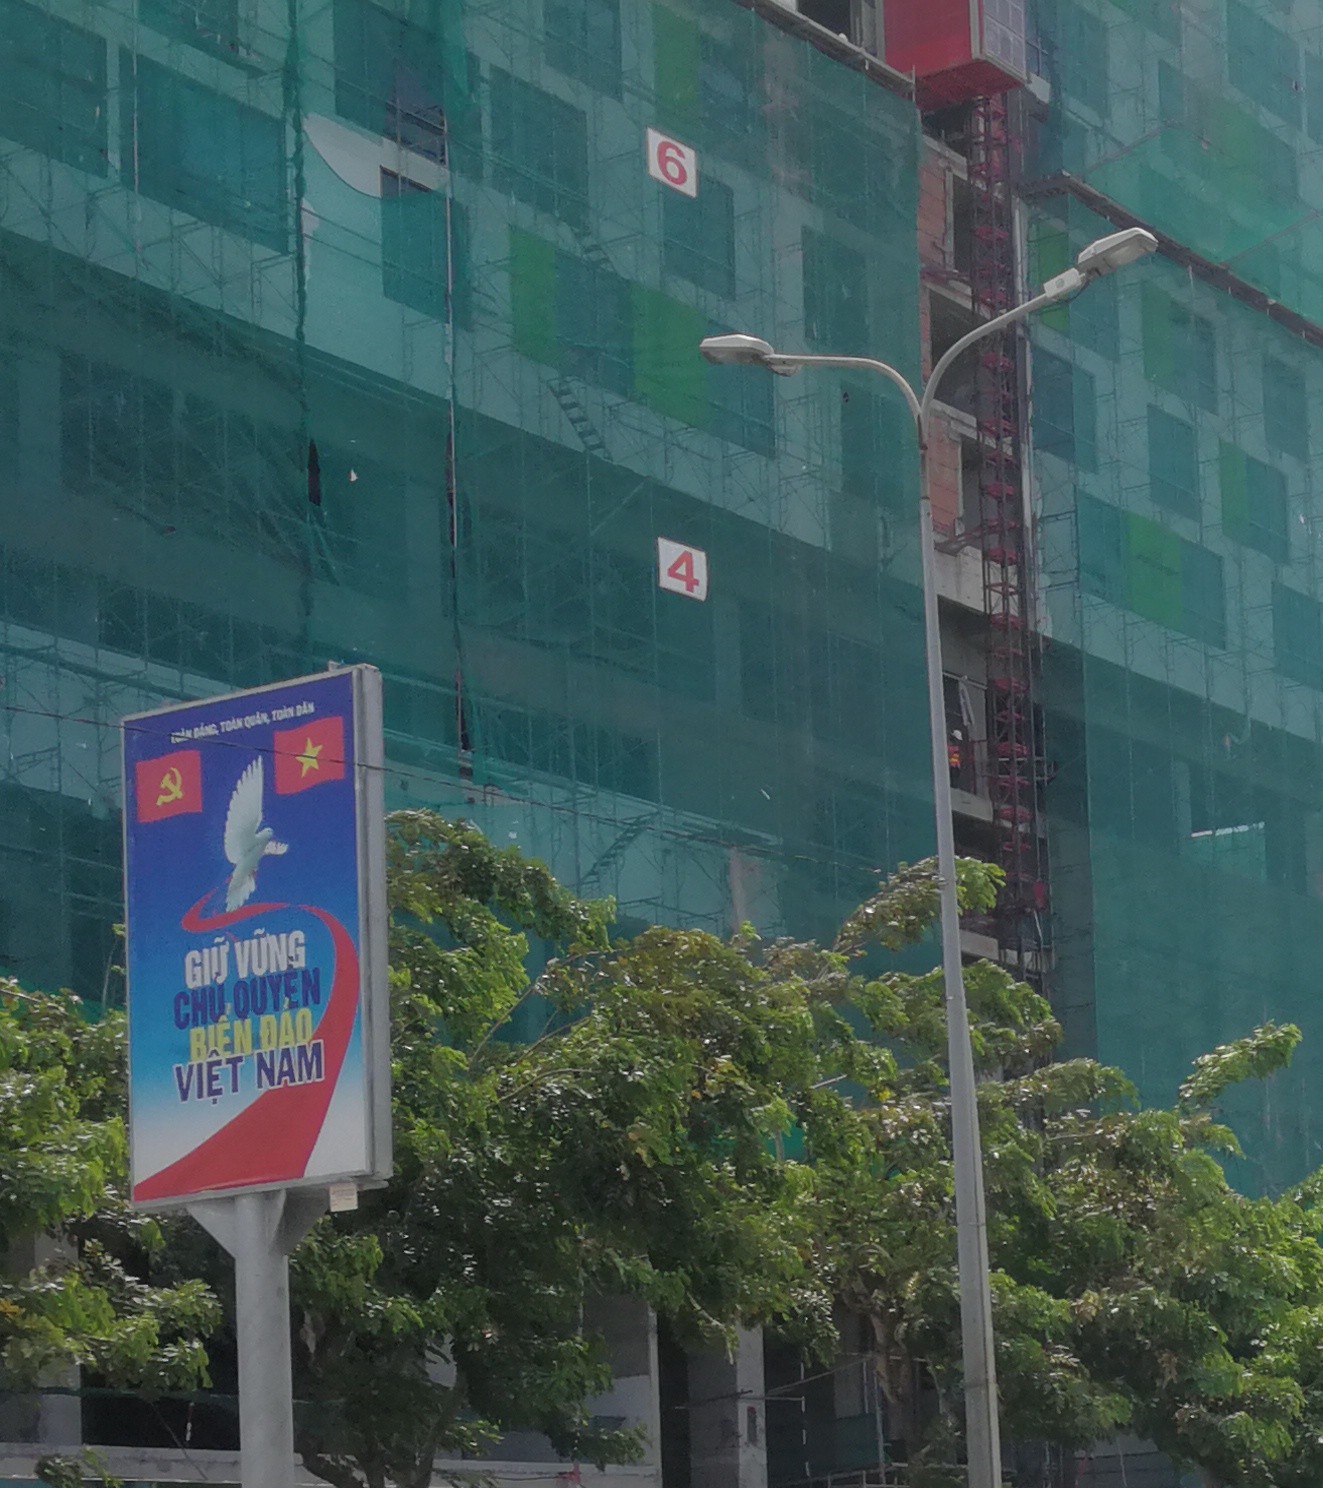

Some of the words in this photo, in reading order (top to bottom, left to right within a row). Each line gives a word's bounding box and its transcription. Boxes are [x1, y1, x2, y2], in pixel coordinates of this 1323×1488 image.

[656, 140, 687, 186] 6
[667, 549, 699, 594] 4
[185, 936, 230, 990] GIỮ
[234, 927, 306, 979] VỮNG
[173, 1047, 245, 1105] VIỆT
[254, 1039, 325, 1089] NAM
